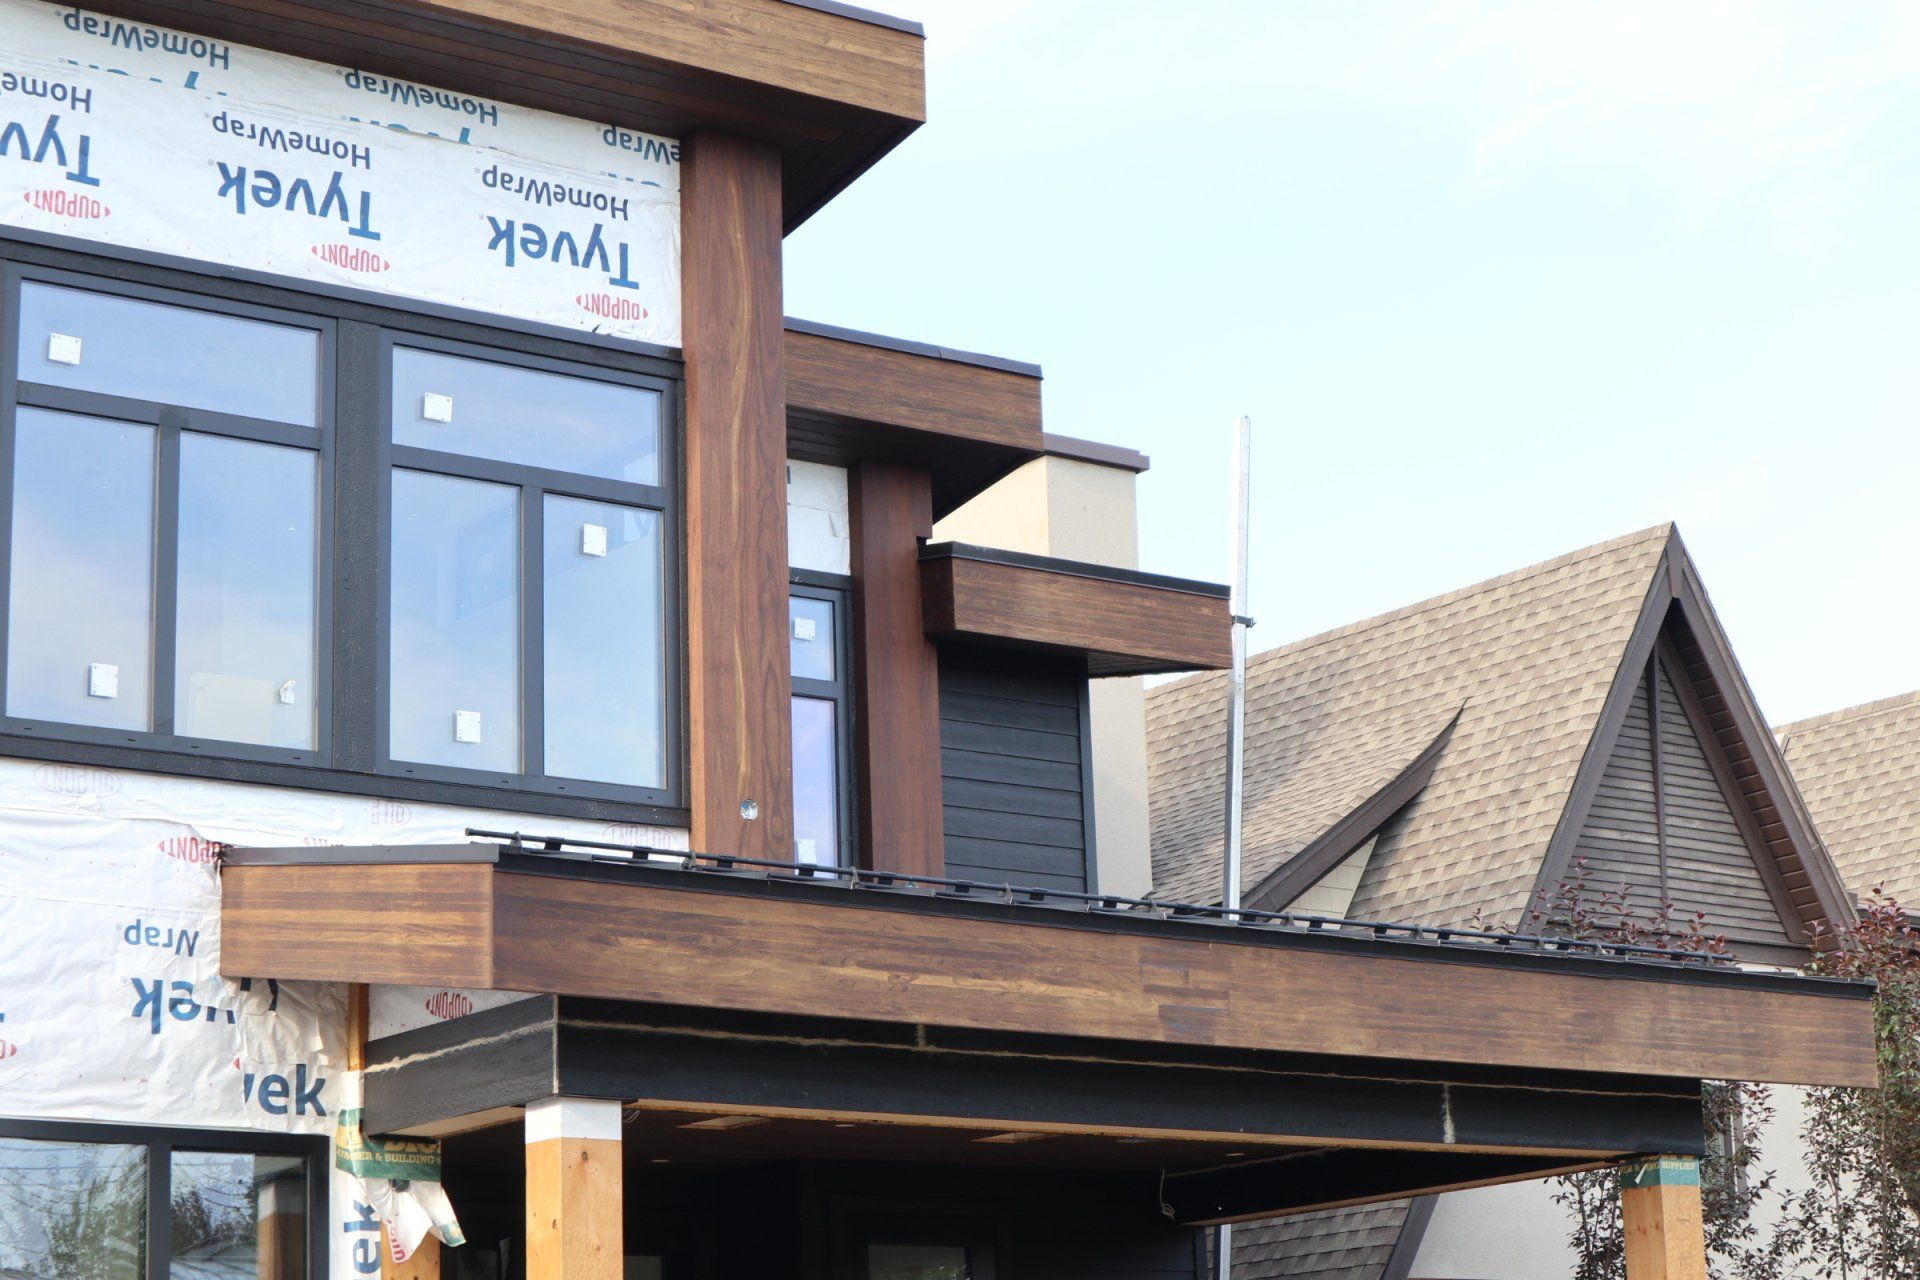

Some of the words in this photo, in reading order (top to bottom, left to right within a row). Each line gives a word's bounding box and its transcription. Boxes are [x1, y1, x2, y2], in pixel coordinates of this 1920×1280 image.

[63, 8, 230, 70] HomeWrap
[345, 68, 498, 127] HomeWrap
[212, 111, 371, 170] HomeWrap
[216, 161, 381, 241] Tyvek
[481, 165, 629, 221] HomeWrap
[486, 215, 640, 290] Tyvek
[167, 836, 220, 864] PONT
[385, 1152, 435, 1164] BUILDING
[1661, 1161, 1696, 1171] SUPPLIES
